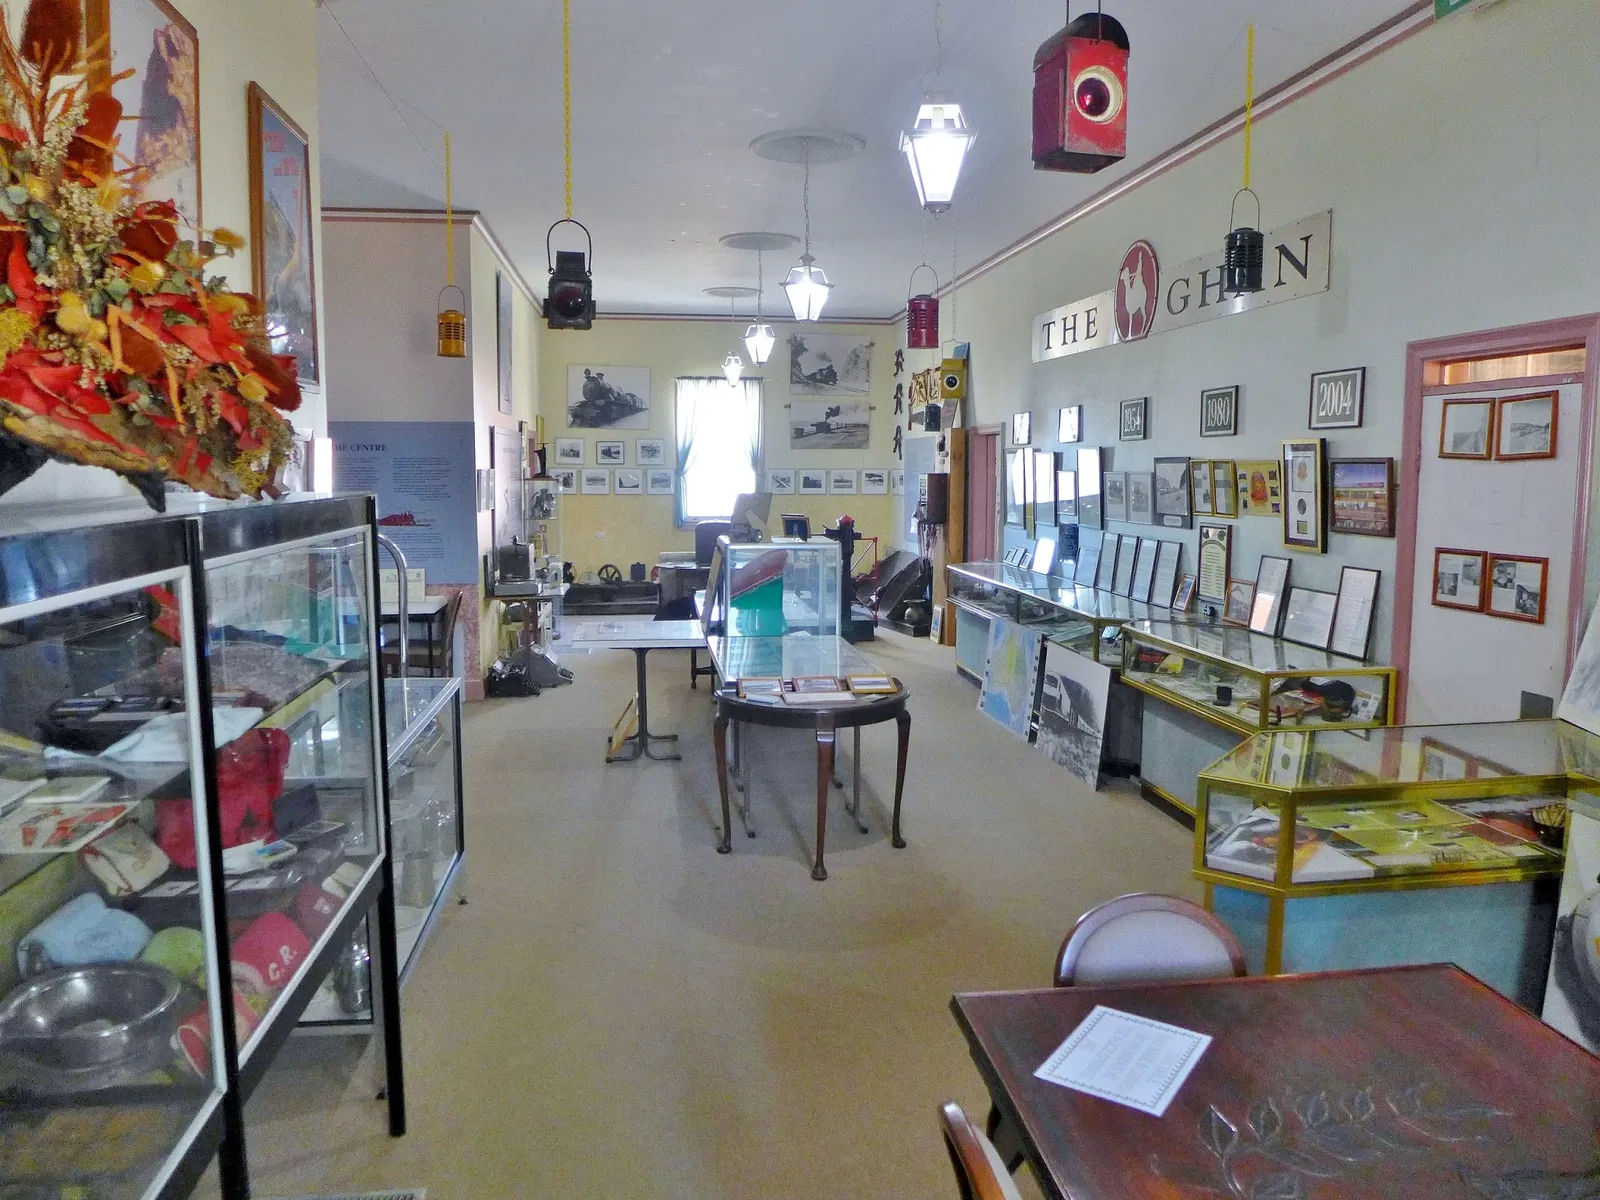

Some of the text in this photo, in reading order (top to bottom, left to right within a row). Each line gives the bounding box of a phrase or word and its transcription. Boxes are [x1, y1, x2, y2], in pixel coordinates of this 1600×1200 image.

[1042, 234, 1314, 352] THE GHN
[1206, 394, 1231, 428] 1980
[1318, 378, 1353, 417] 2004
[1123, 406, 1142, 433] 1954
[350, 443, 387, 452] CENTRE
